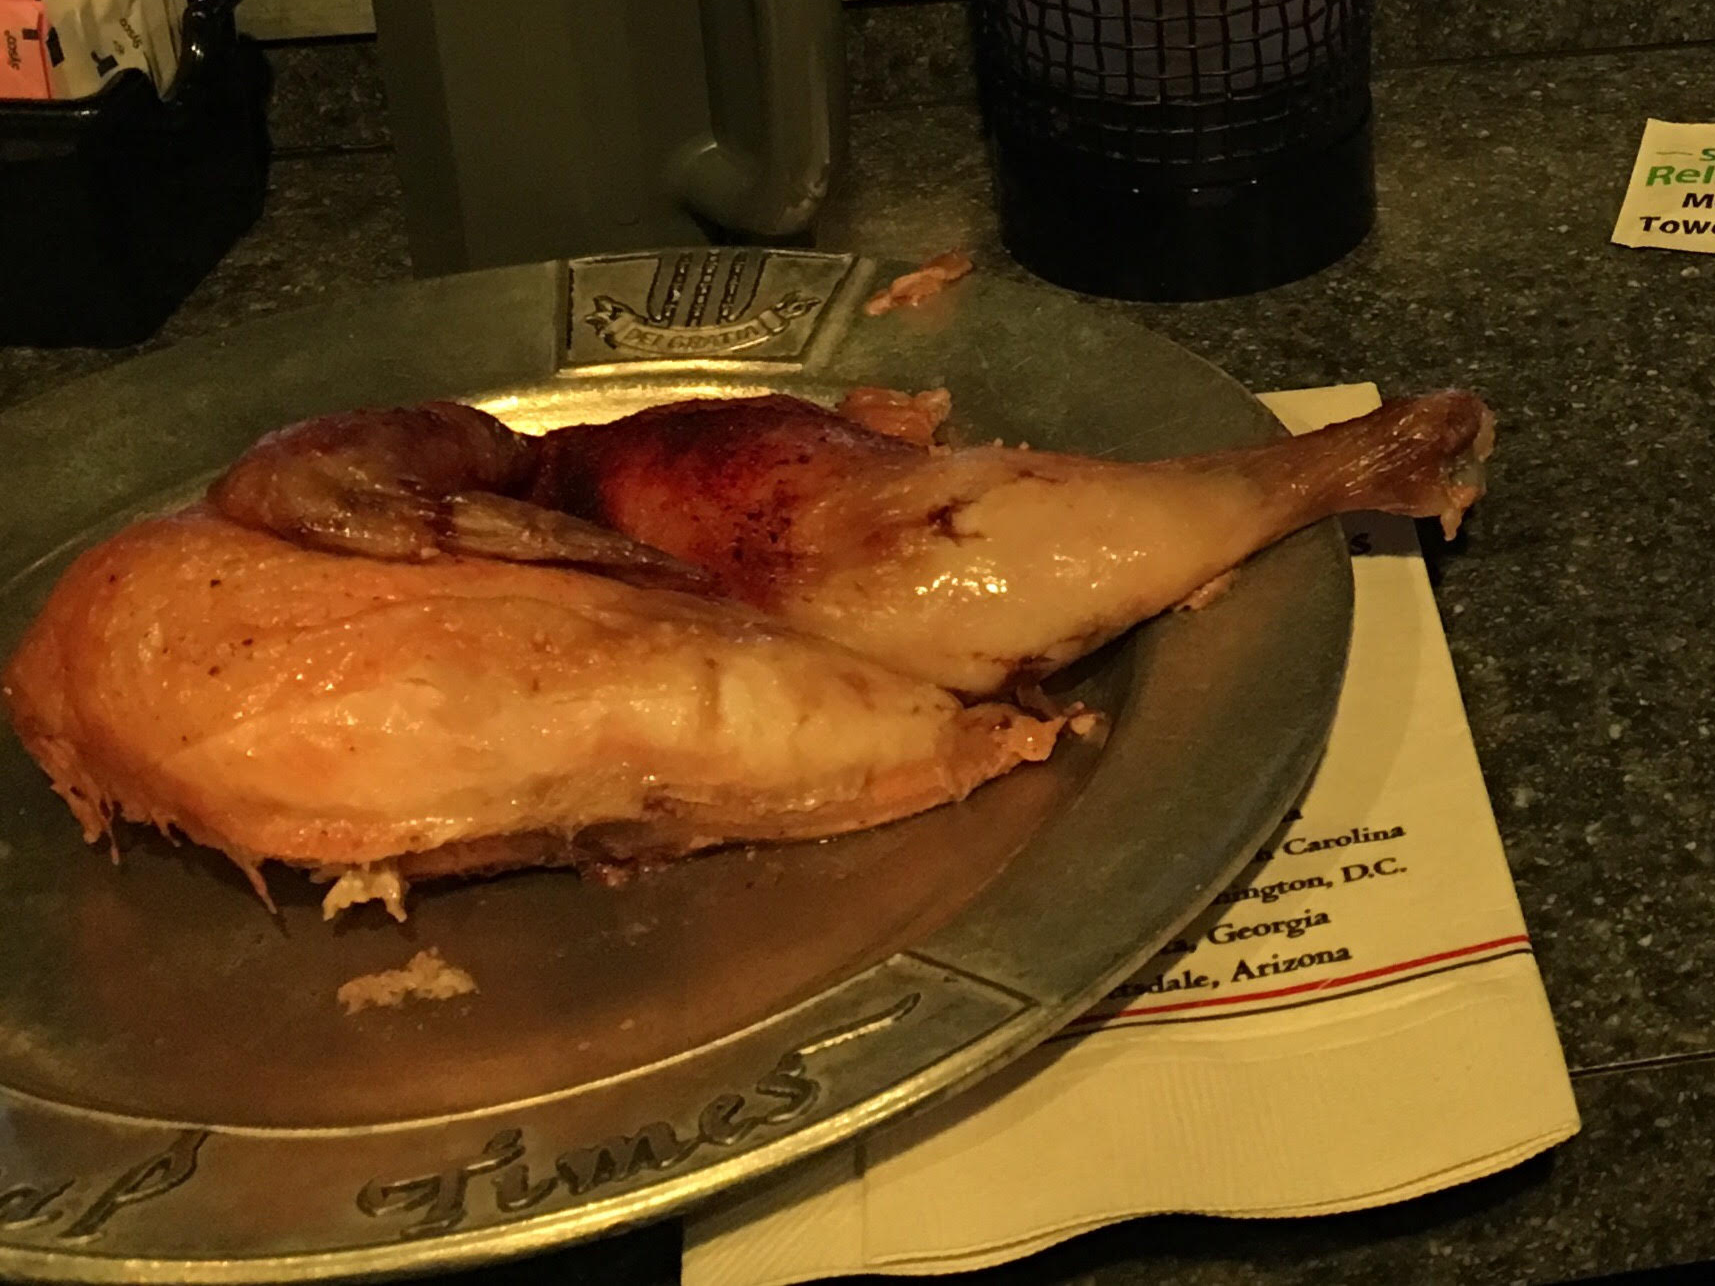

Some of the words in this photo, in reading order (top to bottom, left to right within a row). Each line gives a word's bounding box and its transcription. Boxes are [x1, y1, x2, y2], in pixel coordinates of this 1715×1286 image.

[1282, 822, 1407, 857] Carolina
[1342, 856, 1408, 883] D.C.
[1207, 907, 1332, 945] Georgia
[1230, 944, 1352, 984] Arizona
[356, 991, 922, 1235] Times
